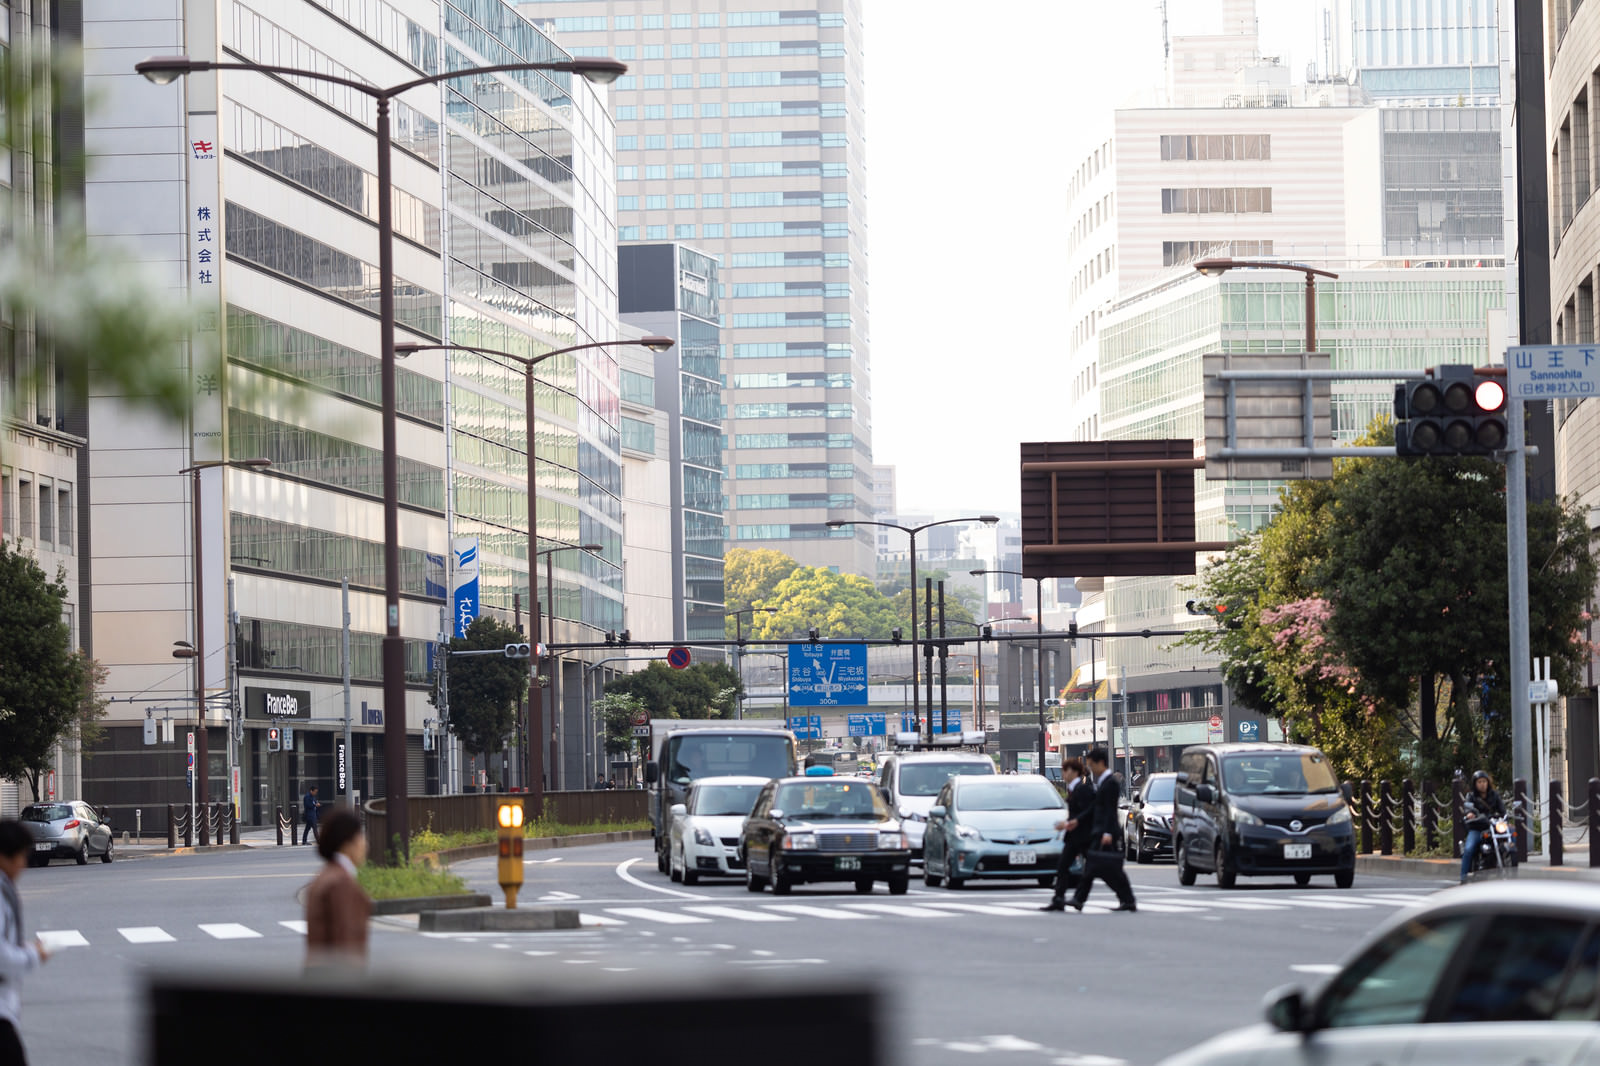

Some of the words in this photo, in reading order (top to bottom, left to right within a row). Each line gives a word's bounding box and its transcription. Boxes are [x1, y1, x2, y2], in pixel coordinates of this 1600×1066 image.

[1516, 349, 1596, 369] 山王下
[1530, 369, 1582, 381] Sannoshita
[792, 667, 811, 676] 渋谷
[839, 666, 864, 676] 三宅坂
